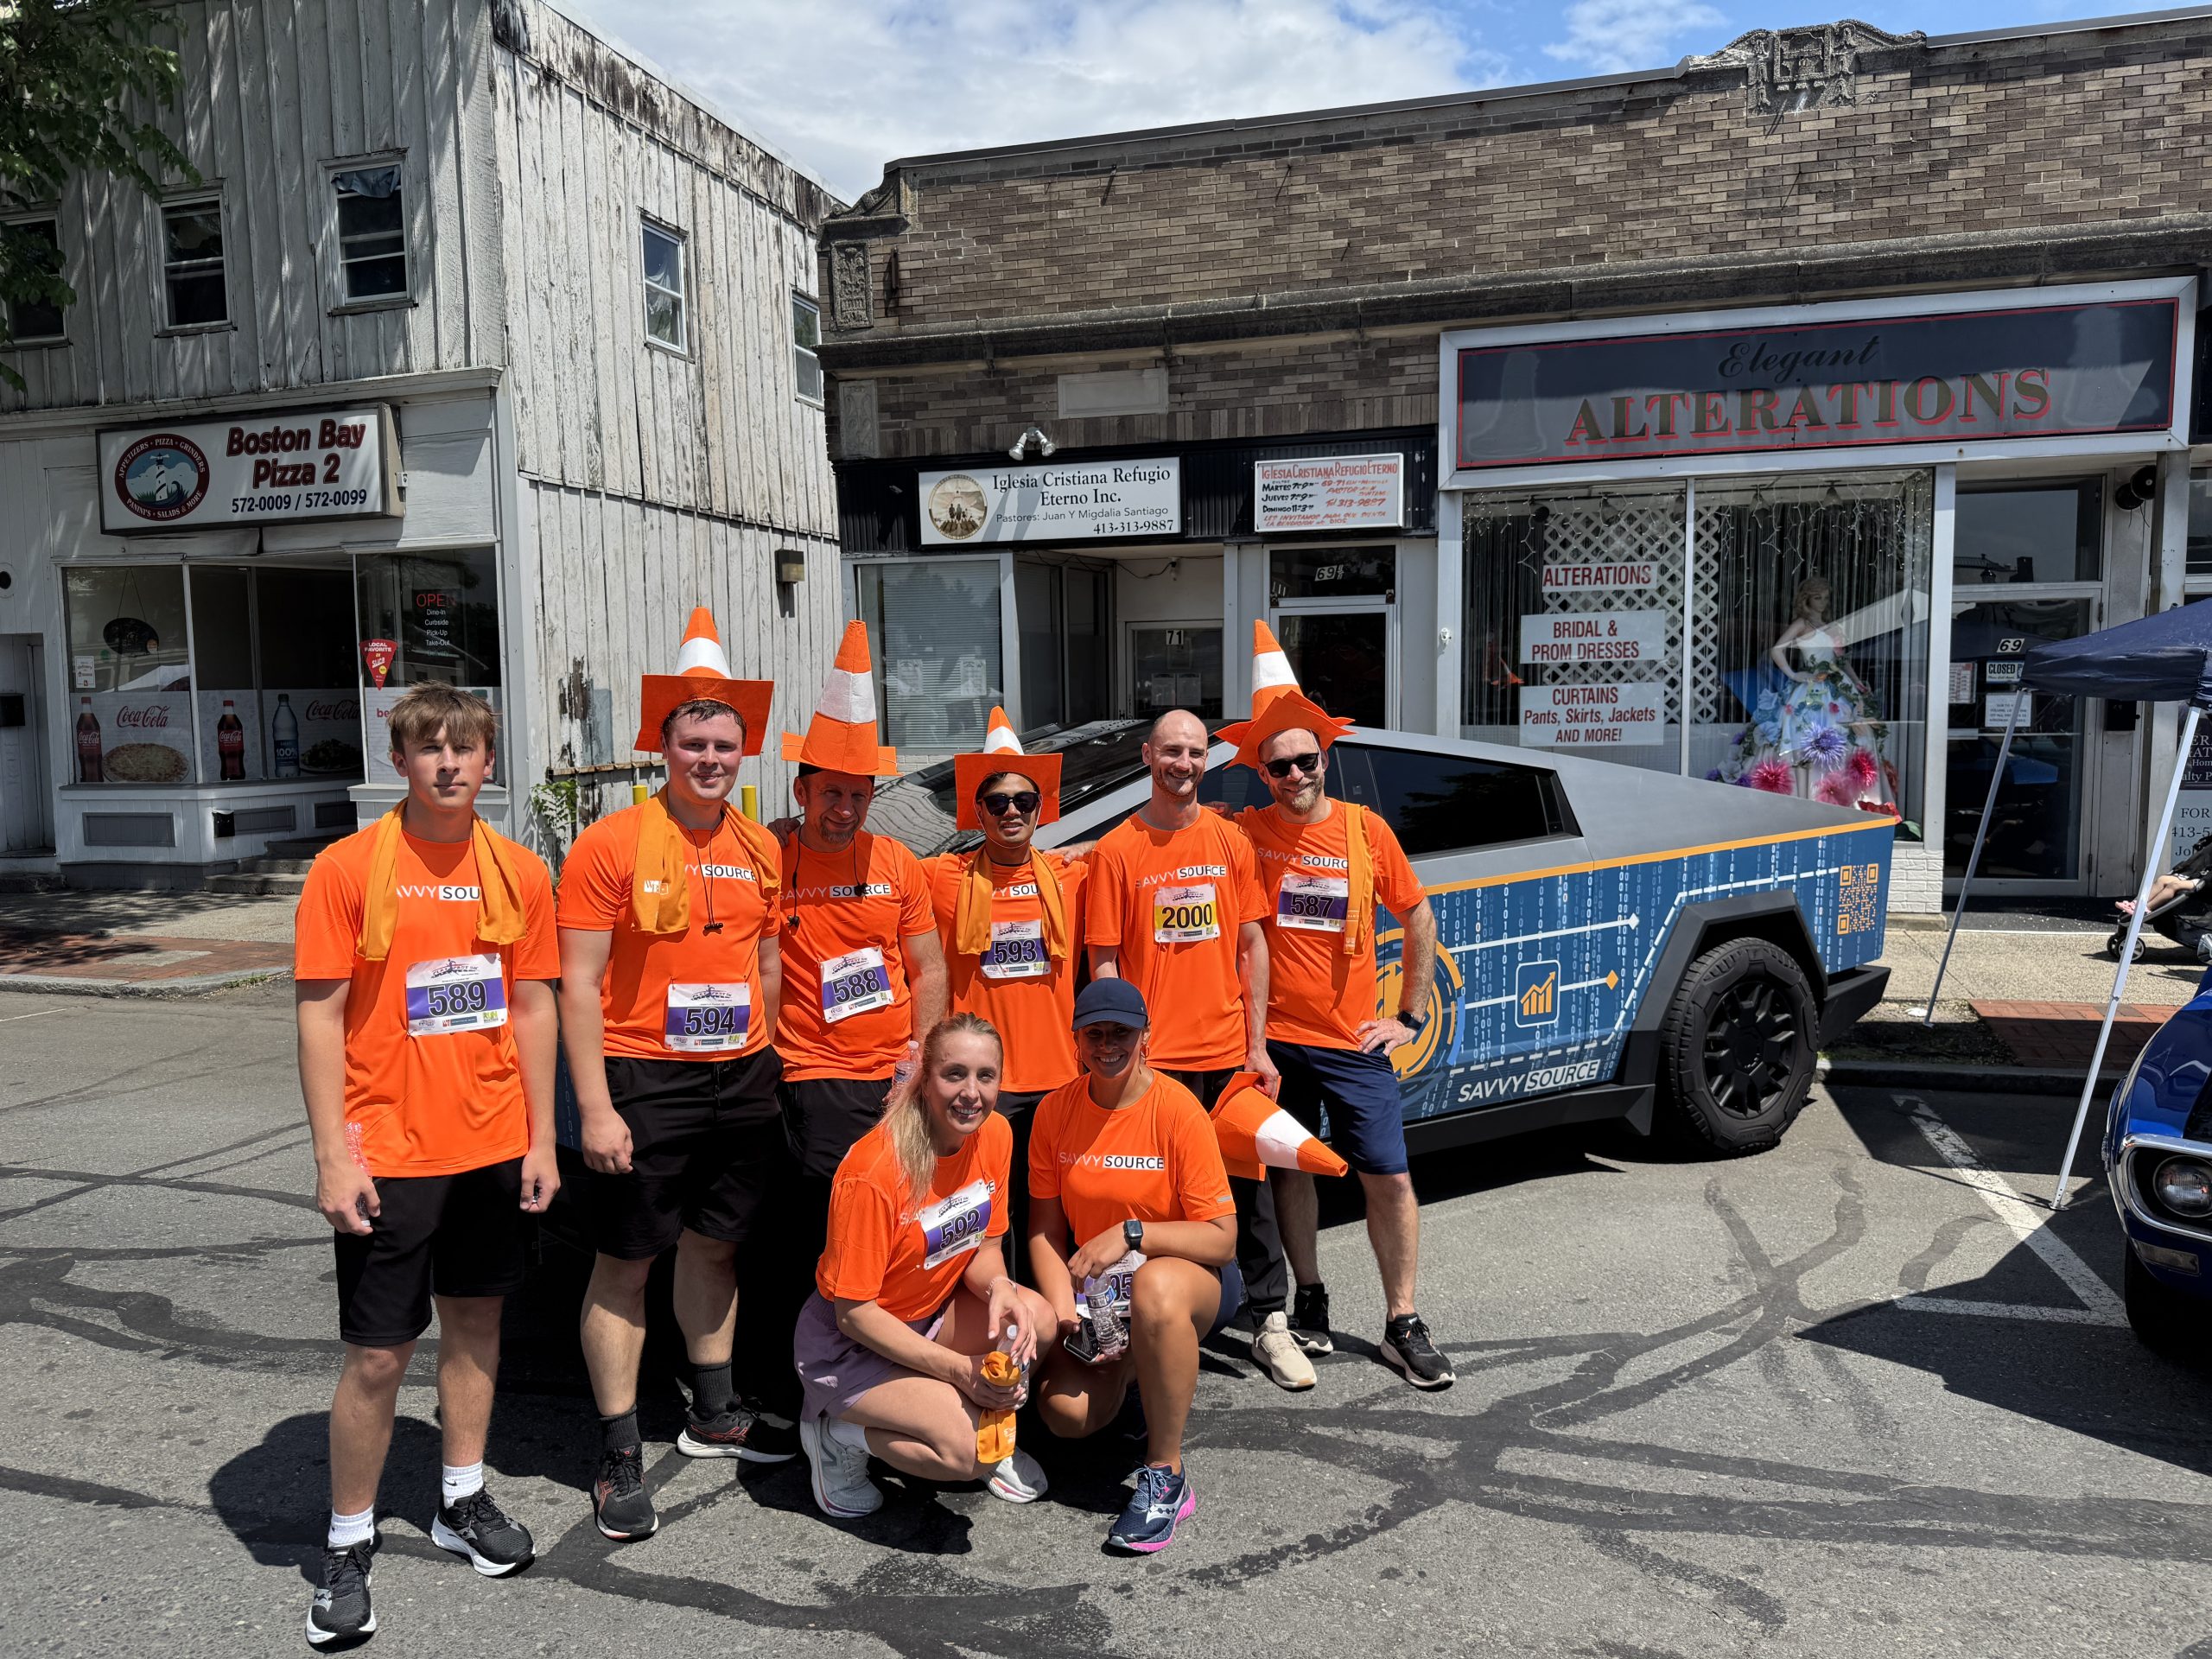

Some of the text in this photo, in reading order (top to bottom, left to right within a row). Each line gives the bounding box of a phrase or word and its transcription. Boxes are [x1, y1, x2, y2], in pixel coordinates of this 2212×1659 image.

[1718, 335, 1881, 383] Elegant
[1563, 367, 2050, 446] ALTERATIONS
[226, 419, 366, 457] Boston Bay
[119, 442, 149, 478] APPETIZERS
[180, 442, 205, 473] GRINDERS
[252, 453, 340, 489] Pizza 2
[1293, 464, 1334, 479] CRISTIANA
[1335, 461, 1367, 476] REFUGIO
[1367, 460, 1398, 474] ETERNO
[993, 474, 1038, 493] Iglesia
[1043, 471, 1107, 487] Cristiana
[1113, 466, 1170, 483] Refugio
[127, 499, 151, 517] PANINI'S
[157, 508, 180, 518] SALADS
[187, 491, 202, 509] MORE
[232, 489, 367, 513] 572-0009 / 572-0099
[1040, 489, 1122, 506] Eterno Inc.
[996, 513, 1039, 523] Pastores:
[1043, 512, 1065, 521] Juan
[1079, 508, 1121, 520] Migdalia
[1124, 506, 1168, 518] Santiago
[1093, 519, 1174, 535] 413-313-9887
[1317, 568, 1335, 579] 69
[1543, 565, 1651, 587] ALTERATIONS
[1167, 631, 1182, 645] 71
[1554, 620, 1618, 639] BRIDAL &
[1532, 641, 1639, 661] PROM DRESSES
[1999, 639, 2022, 652] 69
[1988, 664, 2015, 674] CLOSED
[1553, 687, 1618, 705] CURTAINS
[117, 705, 171, 728] Coca-Cola
[306, 699, 360, 721] Coca-Cola
[1524, 707, 1656, 725] Pants, Skirts, Jackets
[219, 730, 242, 742] Coca-Cola
[1555, 728, 1622, 742] AND MORE!
[2181, 808, 2210, 818] FOR
[1179, 866, 1225, 878] SOURCE
[1303, 855, 1348, 869] SOURC
[1162, 904, 1212, 929] 2000
[1291, 893, 1334, 918] 587
[995, 939, 1037, 963] 593
[832, 968, 880, 1003] 588
[429, 981, 486, 1017] 589
[684, 1007, 734, 1035] 594
[1458, 1060, 1599, 1103] SAVVY SOURCE
[1058, 1152, 1164, 1170] SAVVY SOURCE
[940, 1209, 980, 1250] 592
